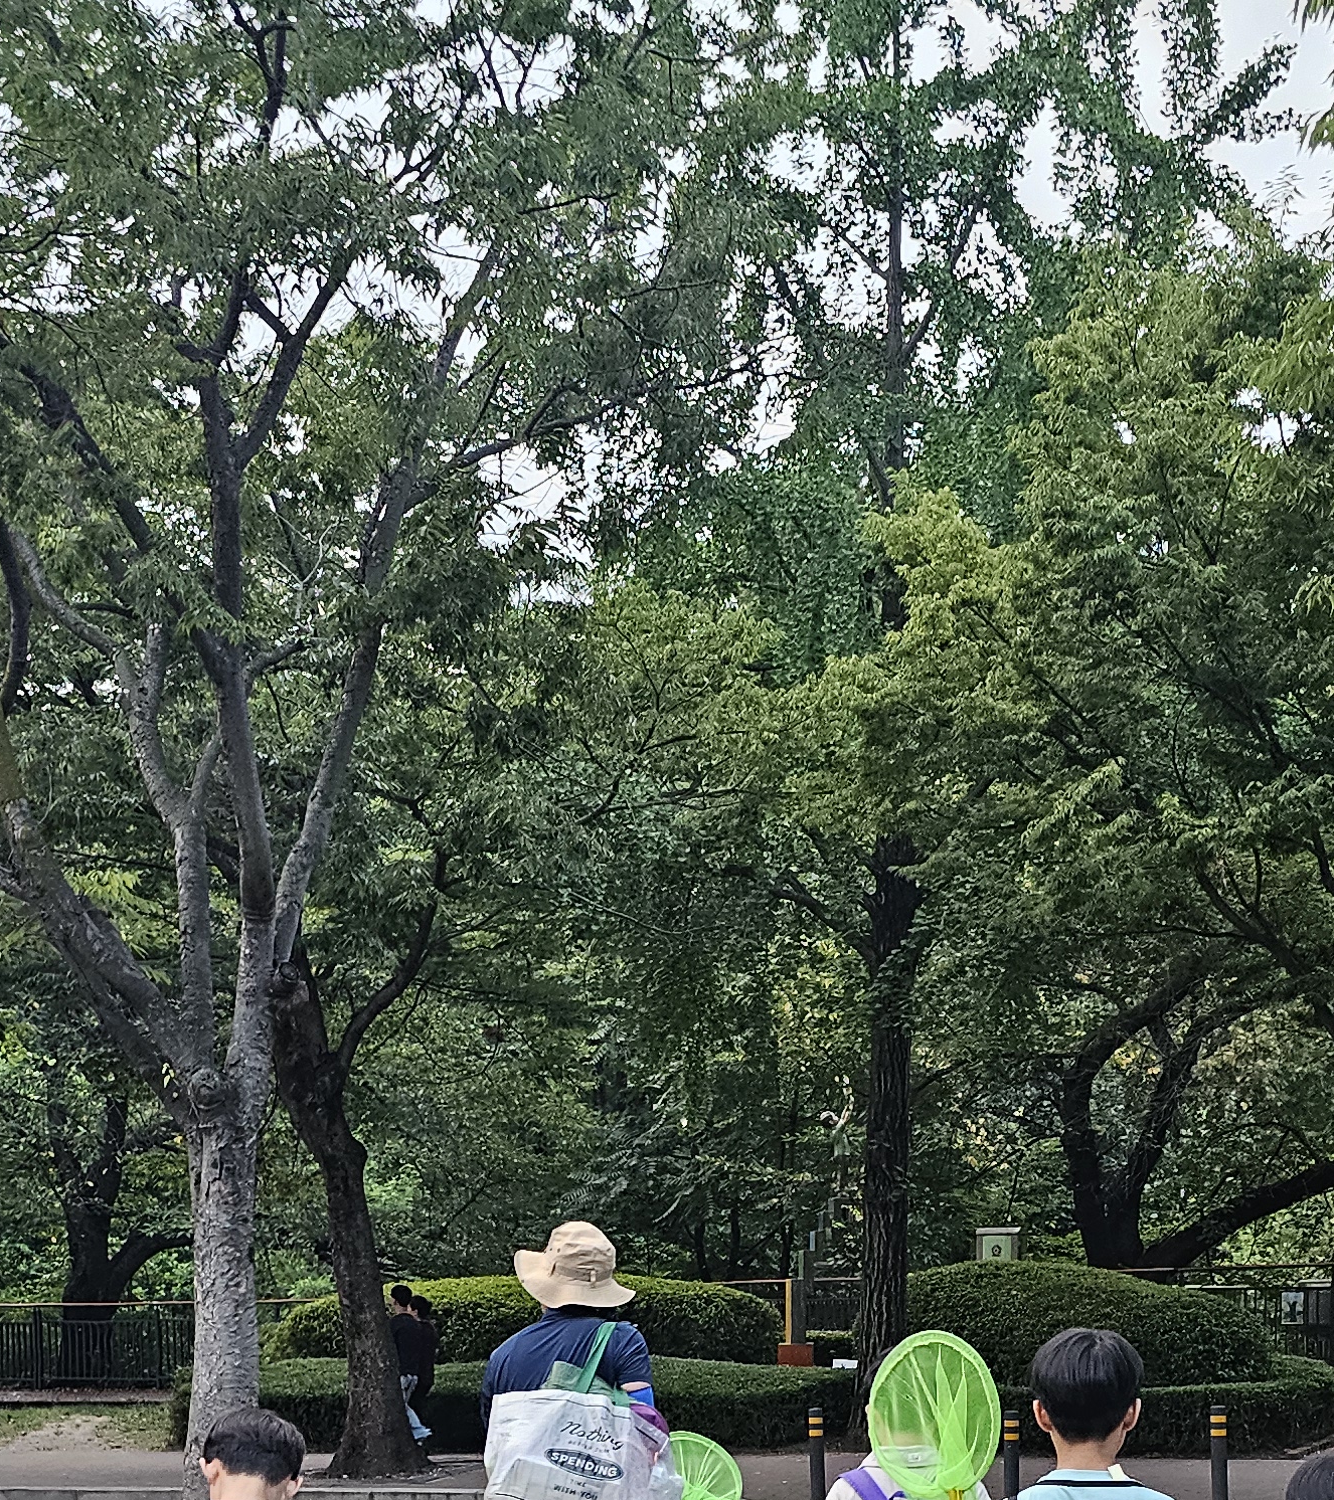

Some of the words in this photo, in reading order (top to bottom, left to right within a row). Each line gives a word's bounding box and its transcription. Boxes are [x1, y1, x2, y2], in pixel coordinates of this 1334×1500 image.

[560, 1421, 624, 1450] Nothing
[551, 1452, 618, 1477] SPENDING
[554, 1485, 576, 1495] WITH
